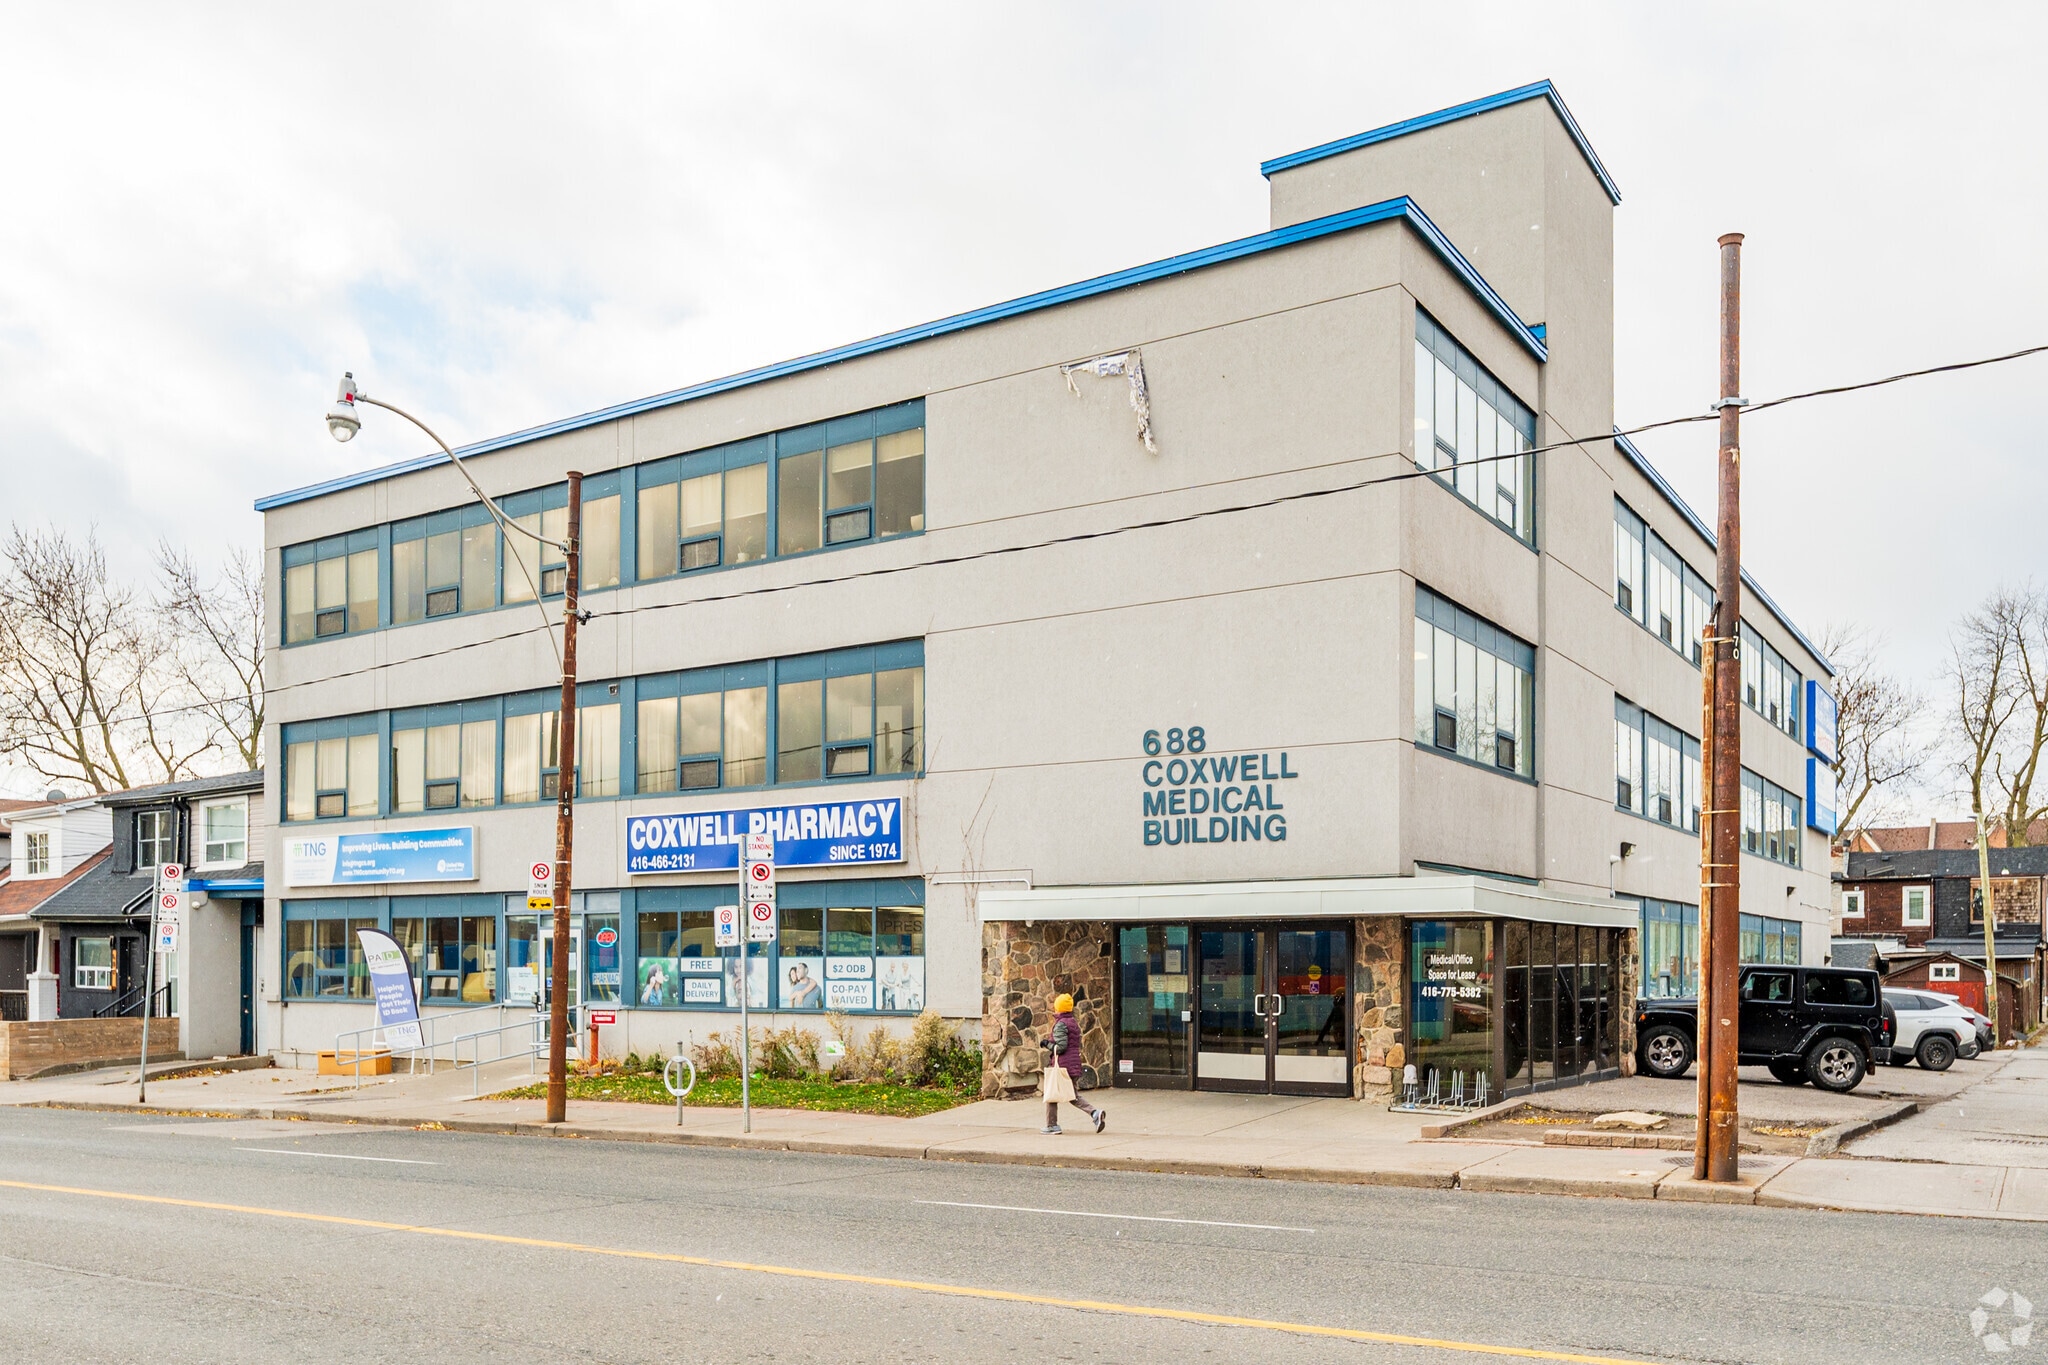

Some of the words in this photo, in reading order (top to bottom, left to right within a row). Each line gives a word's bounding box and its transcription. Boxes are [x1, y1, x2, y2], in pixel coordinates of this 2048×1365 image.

[1143, 726, 1206, 756] 688
[1143, 752, 1298, 787] COXWELL
[1143, 784, 1284, 817] MEDICAL
[630, 814, 740, 851] COXWELL
[748, 802, 896, 842] PHARMACY
[1143, 813, 1287, 846] BUILDING
[303, 842, 327, 857] TNG
[341, 842, 372, 855] Improving
[391, 839, 419, 851] Building
[419, 836, 464, 849] Communities.
[748, 843, 773, 851] STANDING
[829, 844, 866, 861] SINCE
[868, 843, 897, 859] 1974
[630, 853, 695, 870] 416-466-2131
[883, 920, 923, 932] PRES
[597, 931, 616, 944] OPEN
[368, 951, 394, 963] PAID
[1430, 954, 1474, 965] Medical/Office
[690, 960, 713, 970] FREE
[832, 964, 844, 974] $2
[846, 964, 866, 973] ODB
[1428, 969, 1447, 982] Space
[1447, 969, 1457, 980] for
[1457, 969, 1476, 980] Lease
[377, 983, 405, 994] Helping
[685, 990, 719, 998] DELIVERY
[831, 984, 867, 994] CO-PAY
[1421, 986, 1482, 998] 416-775-5382
[379, 992, 403, 1002] People
[831, 995, 868, 1004] WAIVED
[381, 1001, 395, 1009] Get
[394, 998, 412, 1007] Their
[383, 1008, 391, 1017] ID
[391, 1006, 408, 1015] Back
[396, 1025, 417, 1035] TNG
